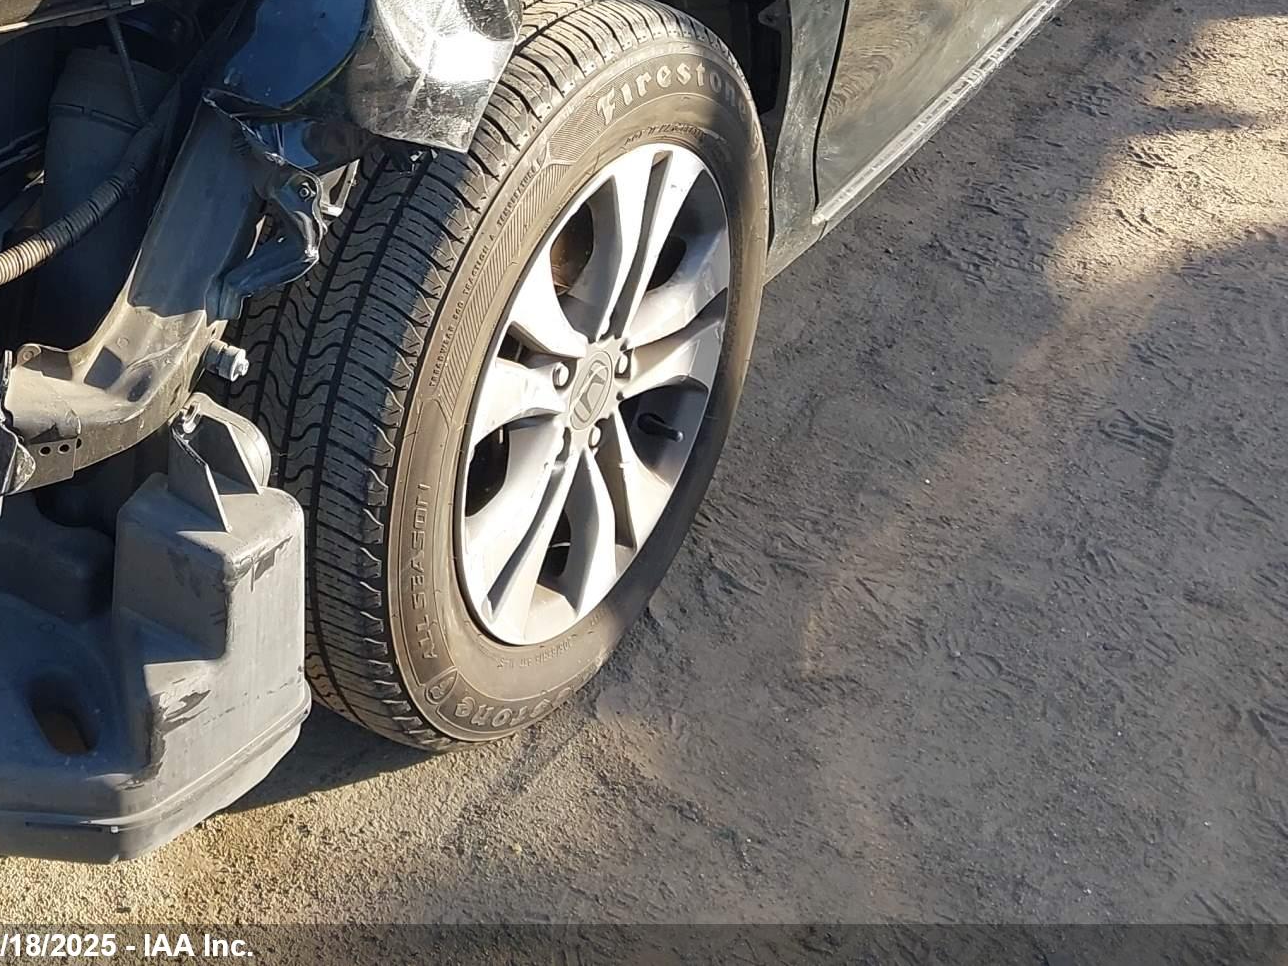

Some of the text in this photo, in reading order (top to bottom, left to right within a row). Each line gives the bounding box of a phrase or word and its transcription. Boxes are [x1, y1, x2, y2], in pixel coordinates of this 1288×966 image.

[596, 62, 748, 126] Firestone
[410, 483, 439, 660] ALL SEASON
